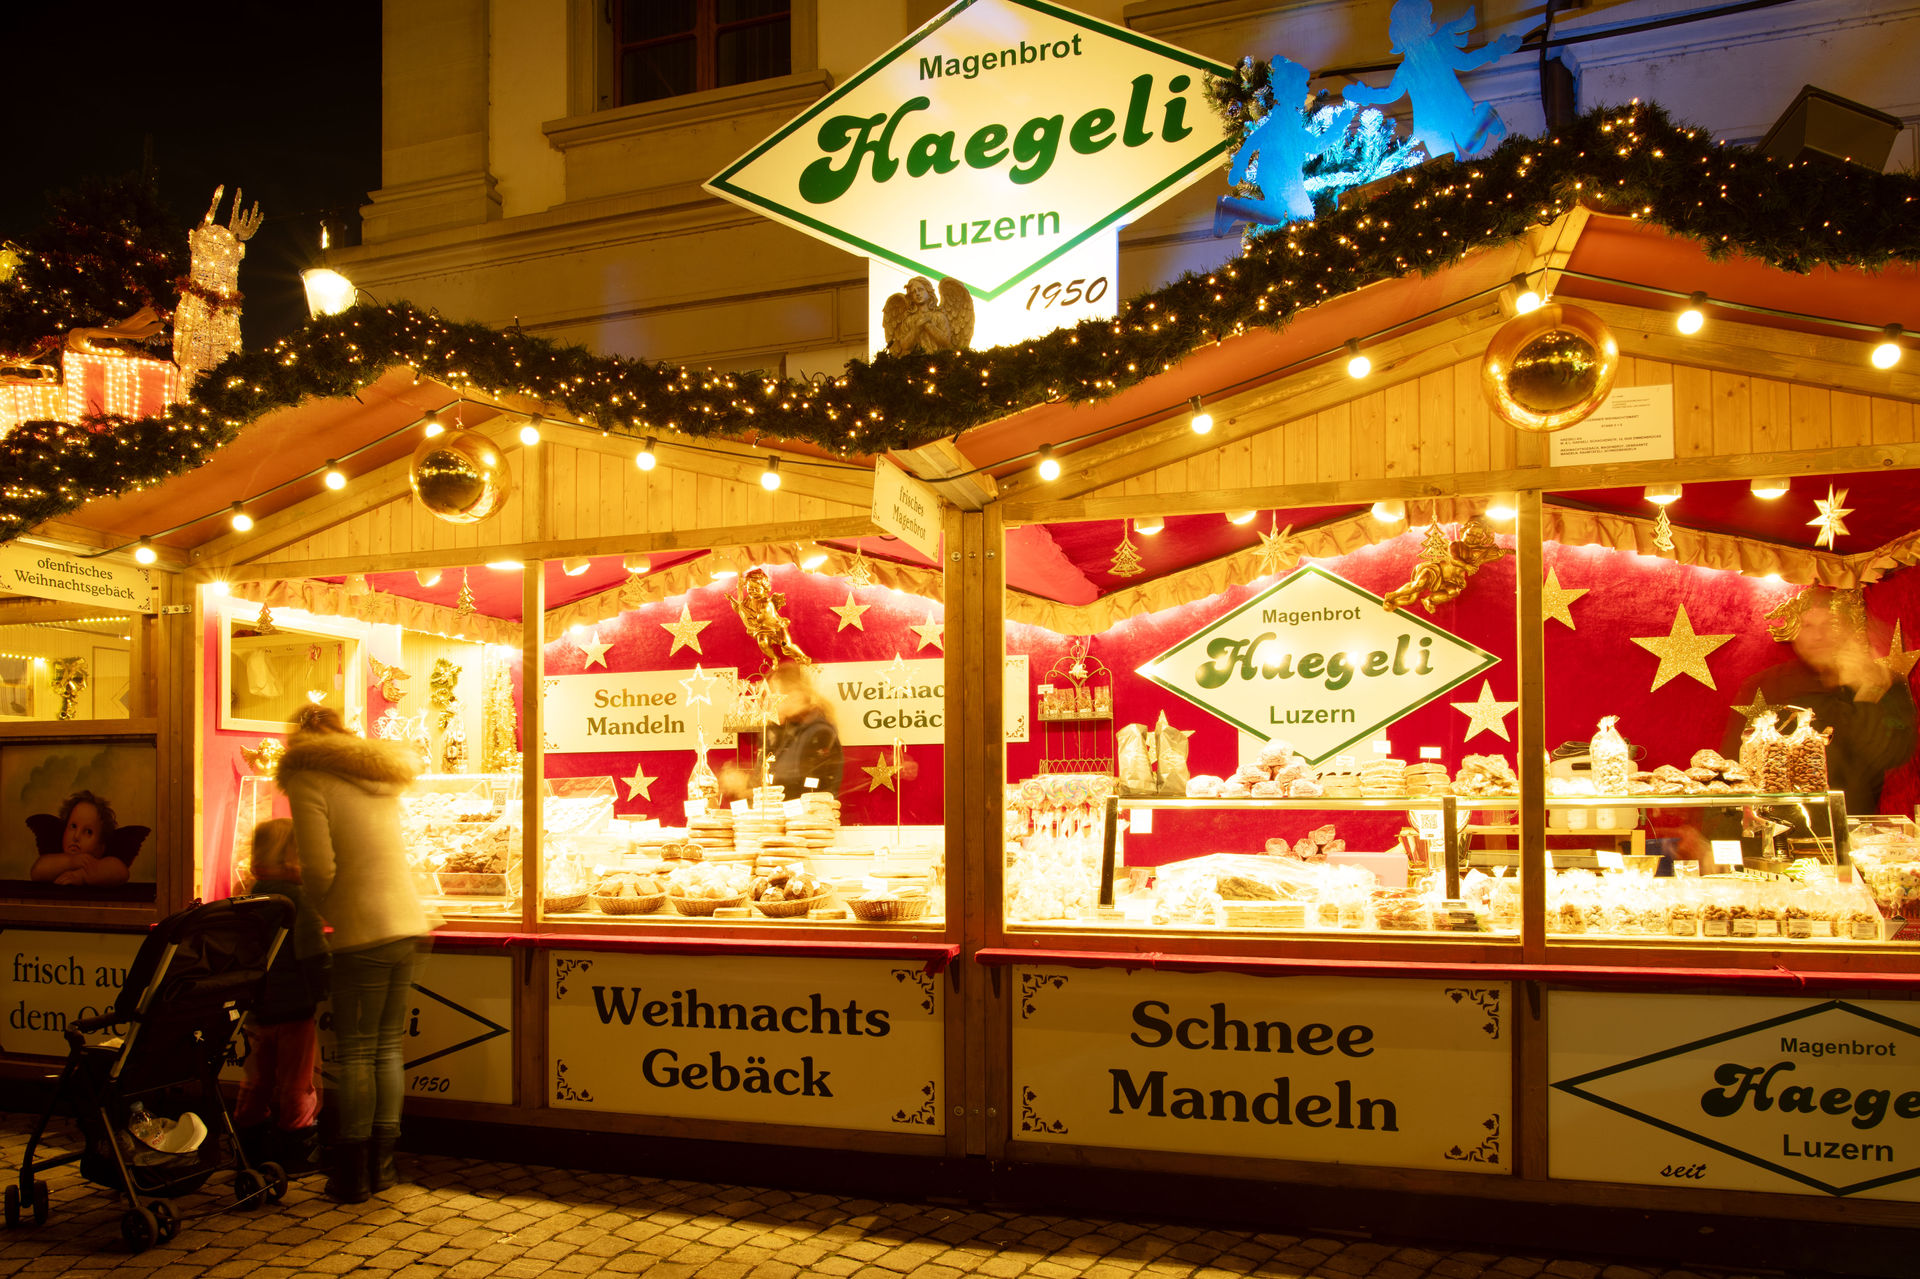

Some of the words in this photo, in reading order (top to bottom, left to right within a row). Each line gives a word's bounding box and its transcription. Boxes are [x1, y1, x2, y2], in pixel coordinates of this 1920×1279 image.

[918, 33, 1083, 81] Magenbrot
[798, 73, 1194, 205] Haegeli
[919, 211, 1061, 251] Luzern
[1025, 276, 1109, 311] 1950
[899, 485, 925, 517] frisches
[892, 503, 926, 541] Magenbrot
[14, 568, 136, 600] Weihnachtsgebäck
[37, 557, 113, 580] ofenfrisches
[1263, 607, 1360, 625] Magenbrot
[1194, 631, 1434, 691] Haegeli
[595, 688, 676, 708] Schnee
[838, 682, 944, 701] Weinac
[587, 714, 685, 735] Mandeln
[862, 708, 944, 730] Gebäc
[1271, 706, 1354, 724] Luzern
[13, 953, 85, 985] frisch
[95, 966, 127, 988] au
[10, 1000, 67, 1033] dem
[592, 986, 890, 1037] Weihnachts
[1131, 1001, 1374, 1057] Schnee
[1781, 1038, 1896, 1057] Magenbrot
[411, 1075, 450, 1093] 1950
[643, 1049, 833, 1097] Gebäck
[1109, 1069, 1399, 1131] Mandeln
[1701, 1062, 1920, 1129] Haege
[1784, 1134, 1893, 1162] Luzern
[1660, 1164, 1706, 1179] seit
